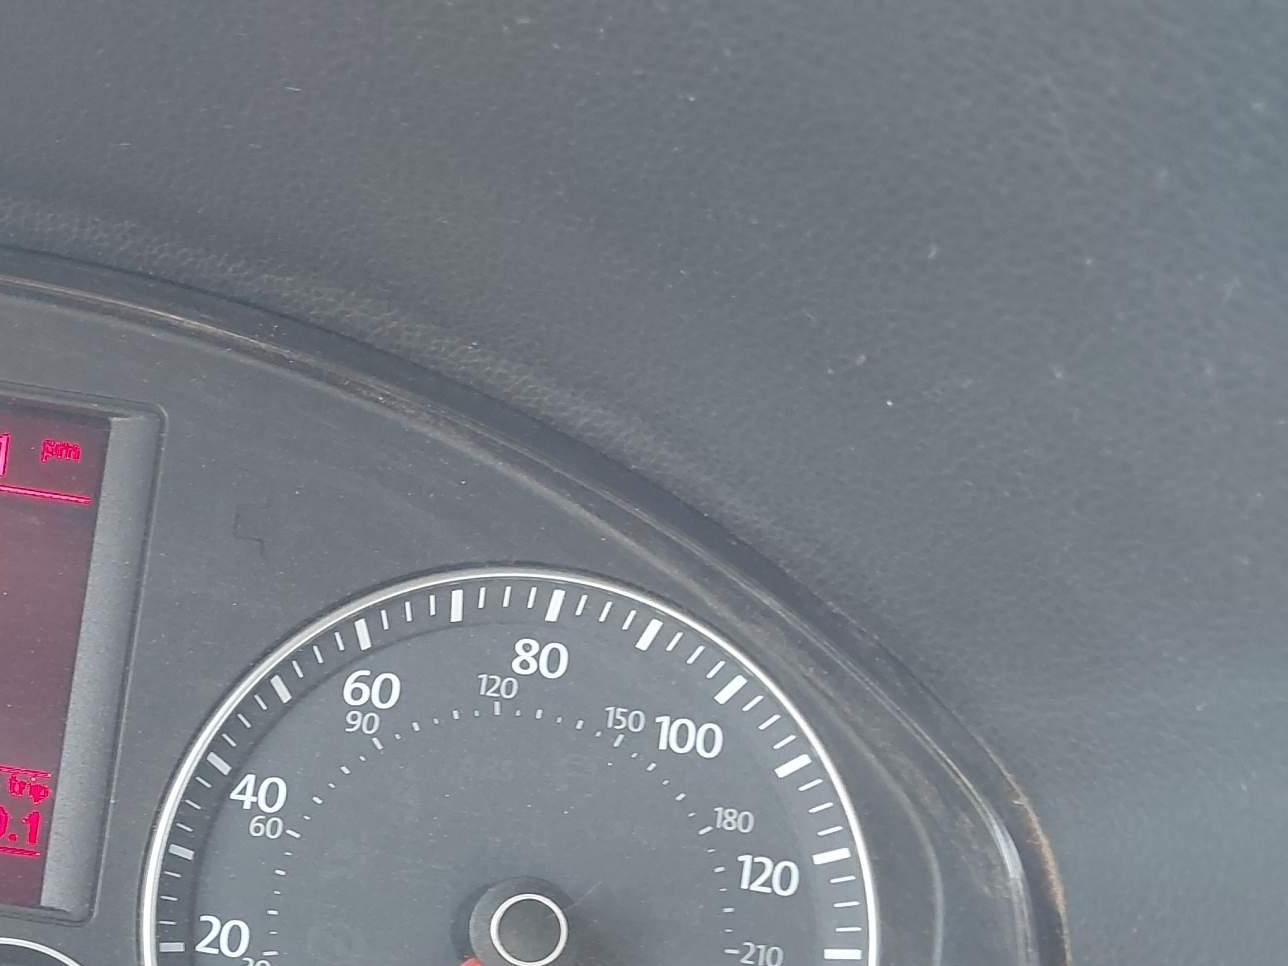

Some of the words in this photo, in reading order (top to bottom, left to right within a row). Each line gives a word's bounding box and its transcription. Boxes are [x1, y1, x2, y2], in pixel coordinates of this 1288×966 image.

[41, 438, 81, 462] pm
[511, 638, 569, 679] 80
[342, 670, 400, 711] 60
[477, 674, 518, 700] 120
[344, 710, 380, 735] 90
[605, 706, 645, 734] 150
[656, 716, 724, 760] 100
[8, 773, 49, 803] trip
[230, 774, 287, 814] 40
[248, 814, 283, 840] 60
[713, 806, 754, 835] 180
[737, 853, 799, 897] 120
[195, 915, 250, 957] 20
